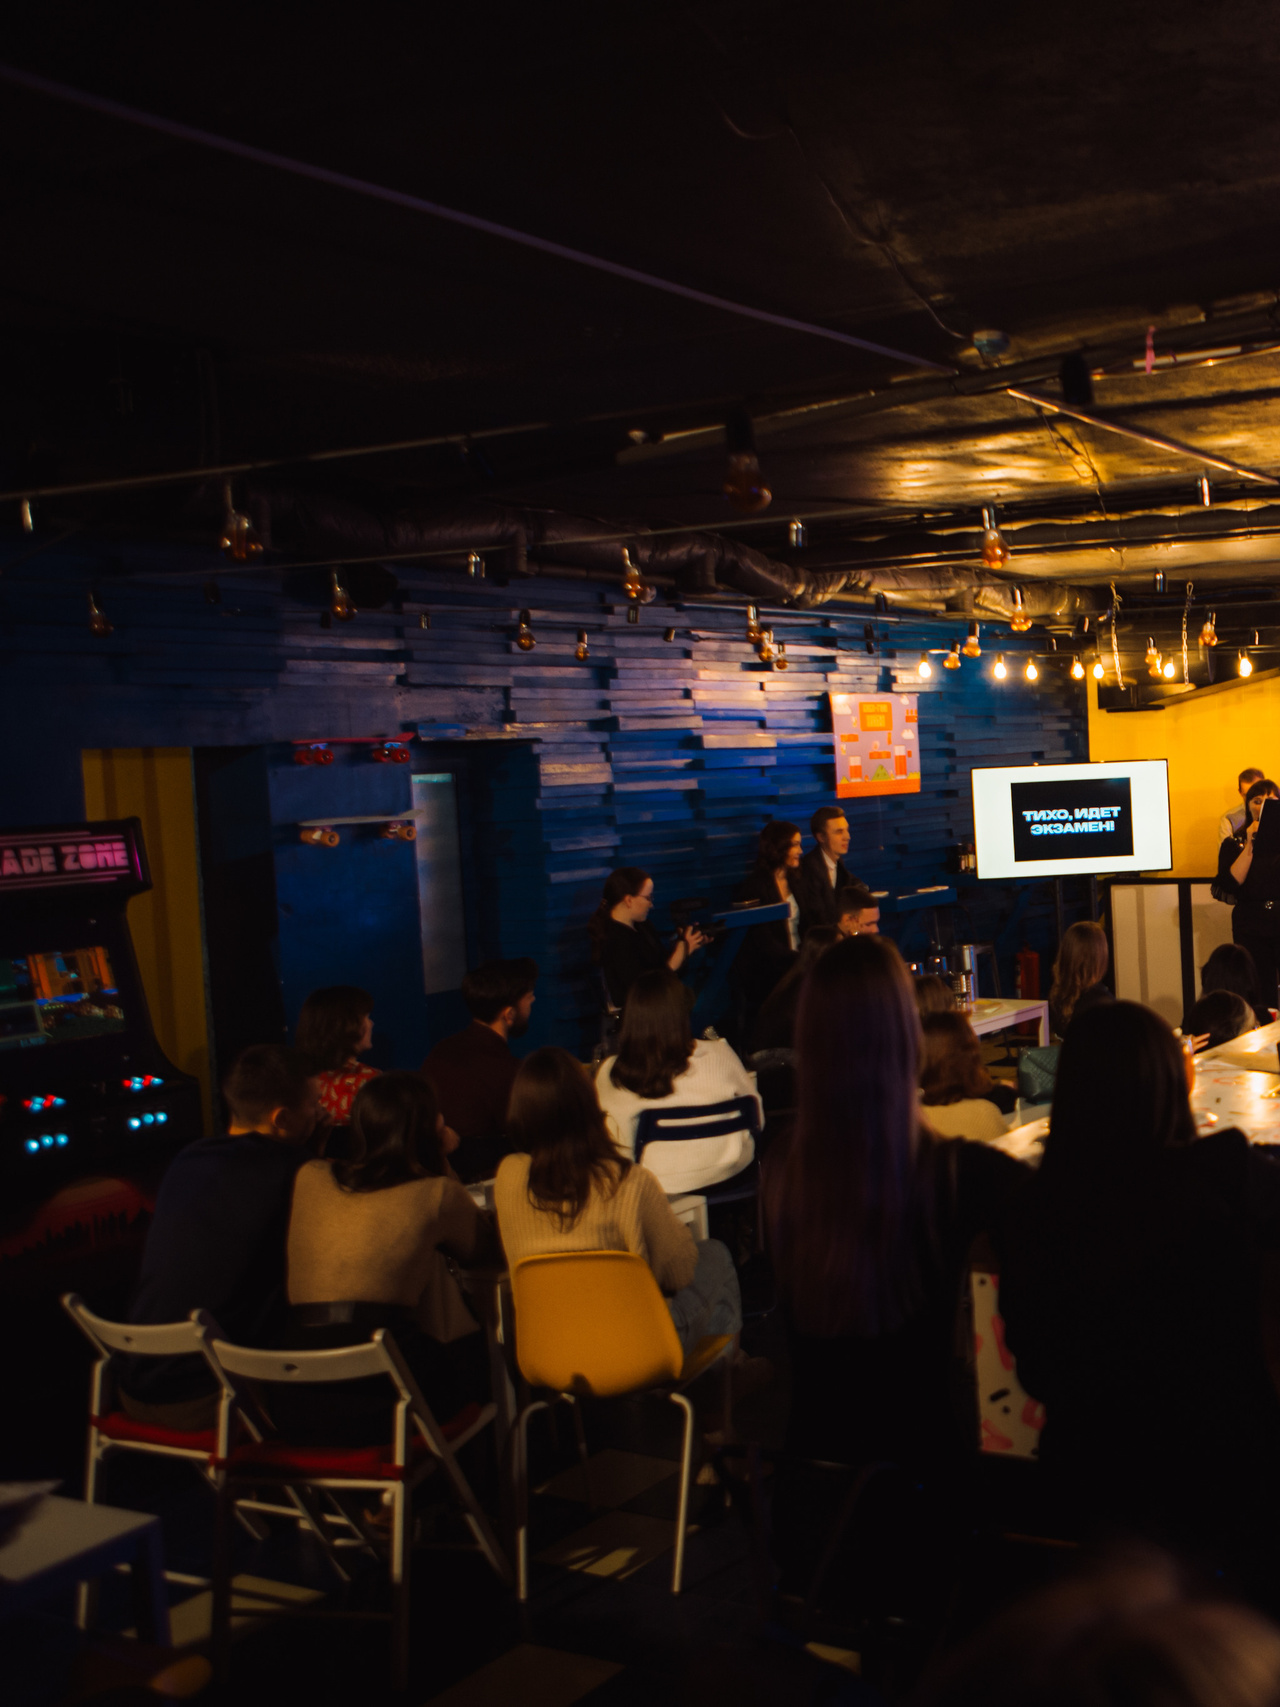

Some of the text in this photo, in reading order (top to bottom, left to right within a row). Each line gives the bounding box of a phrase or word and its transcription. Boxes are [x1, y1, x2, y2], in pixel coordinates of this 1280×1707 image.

[1022, 806, 1121, 822] ТИХО, ИДЕТ
[1030, 820, 1115, 836] ЭКЗАМЕН!
[0, 841, 130, 876] ADE ZONE
